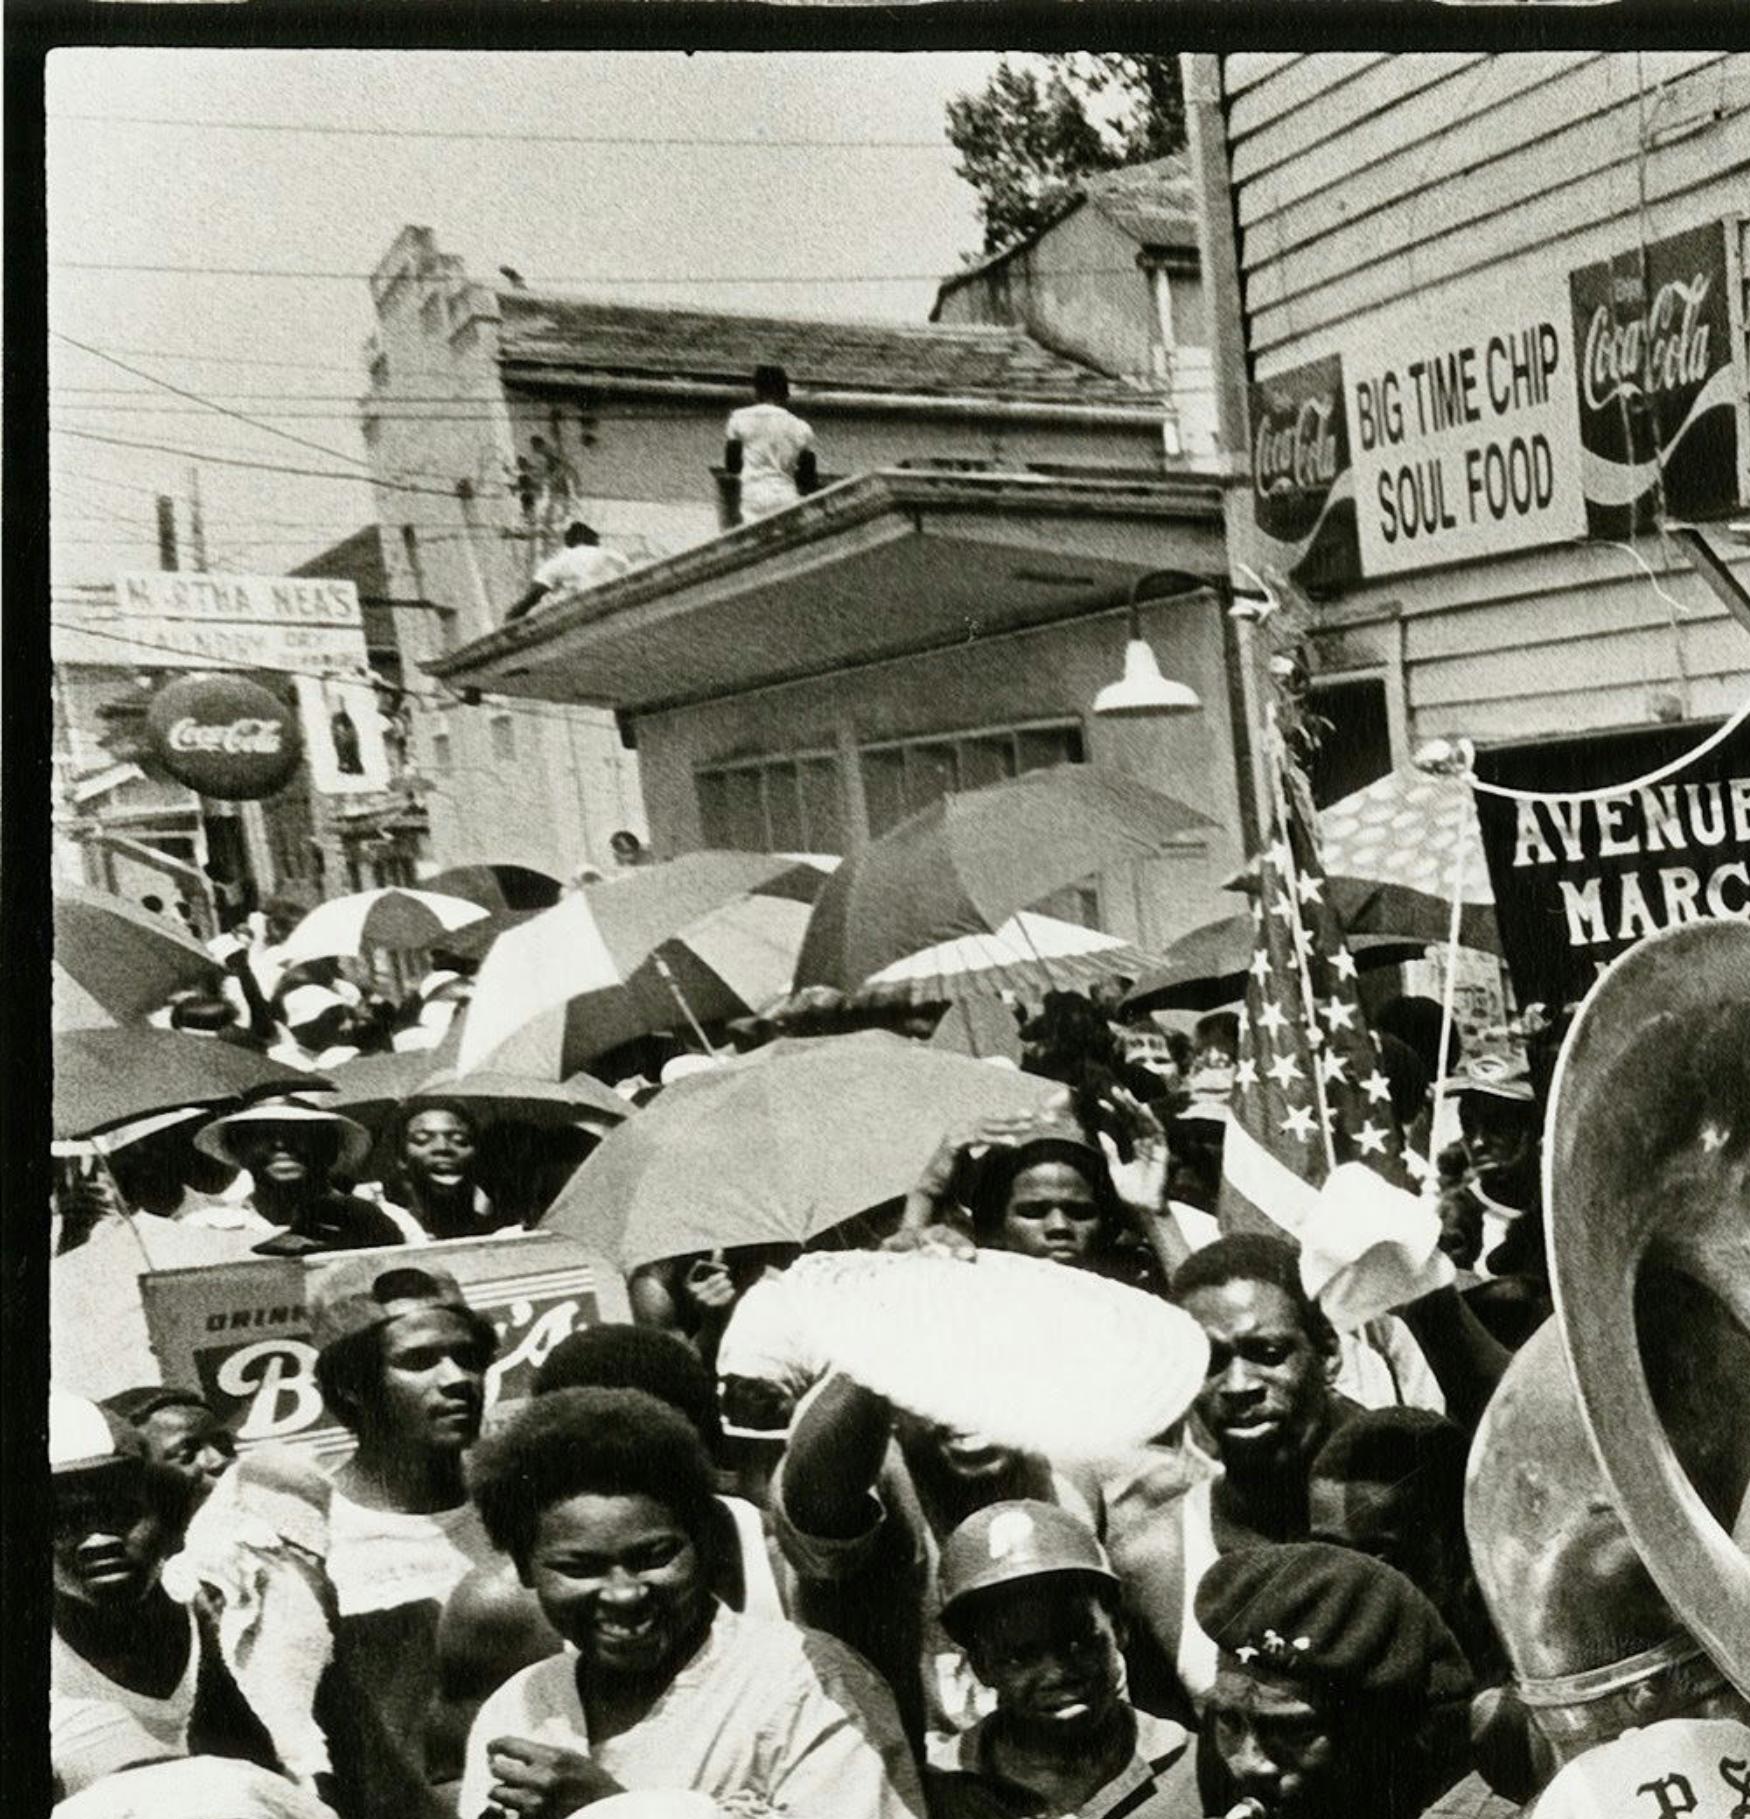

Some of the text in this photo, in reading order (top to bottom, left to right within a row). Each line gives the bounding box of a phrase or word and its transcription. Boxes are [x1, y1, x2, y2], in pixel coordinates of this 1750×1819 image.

[1356, 322, 1559, 451] BIG TIME CHIP
[1377, 433, 1553, 544] SOUL FOOD
